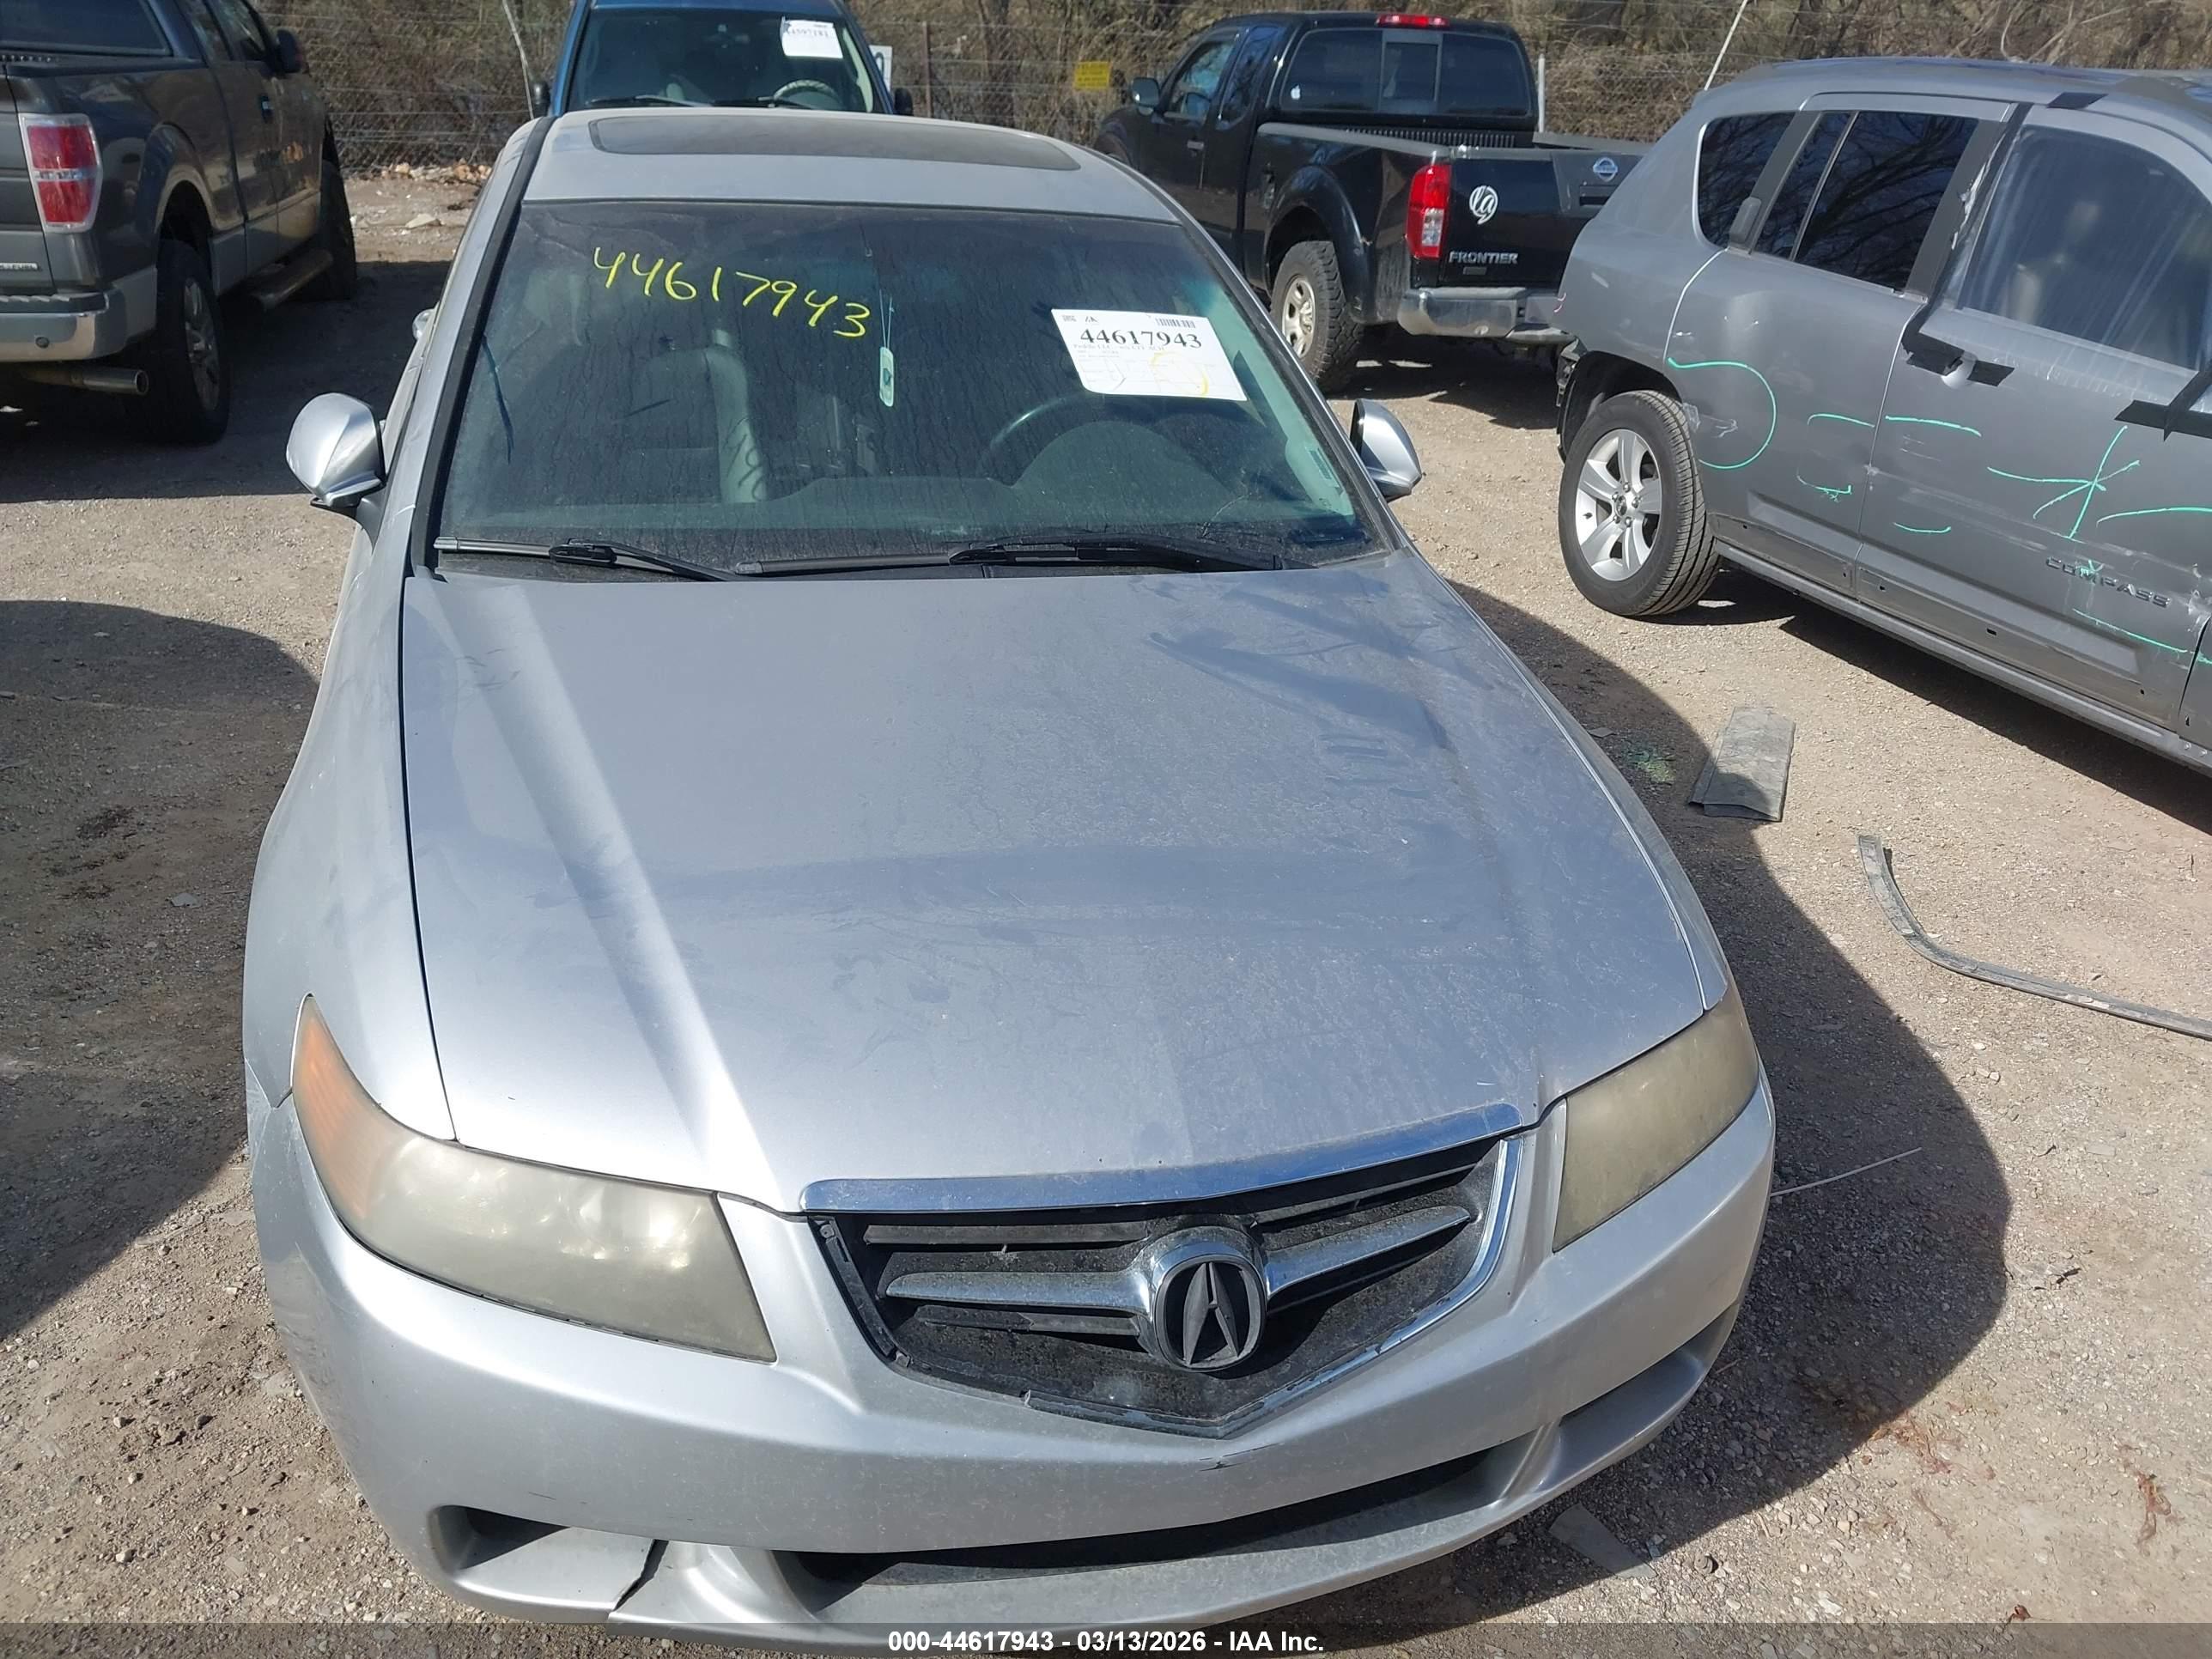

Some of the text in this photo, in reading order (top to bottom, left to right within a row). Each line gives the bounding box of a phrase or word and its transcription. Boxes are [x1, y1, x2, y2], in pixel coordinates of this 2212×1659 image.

[1449, 251, 1519, 264] FRONTIER
[593, 246, 871, 337] 44617943
[1079, 328, 1202, 349] 44617943
